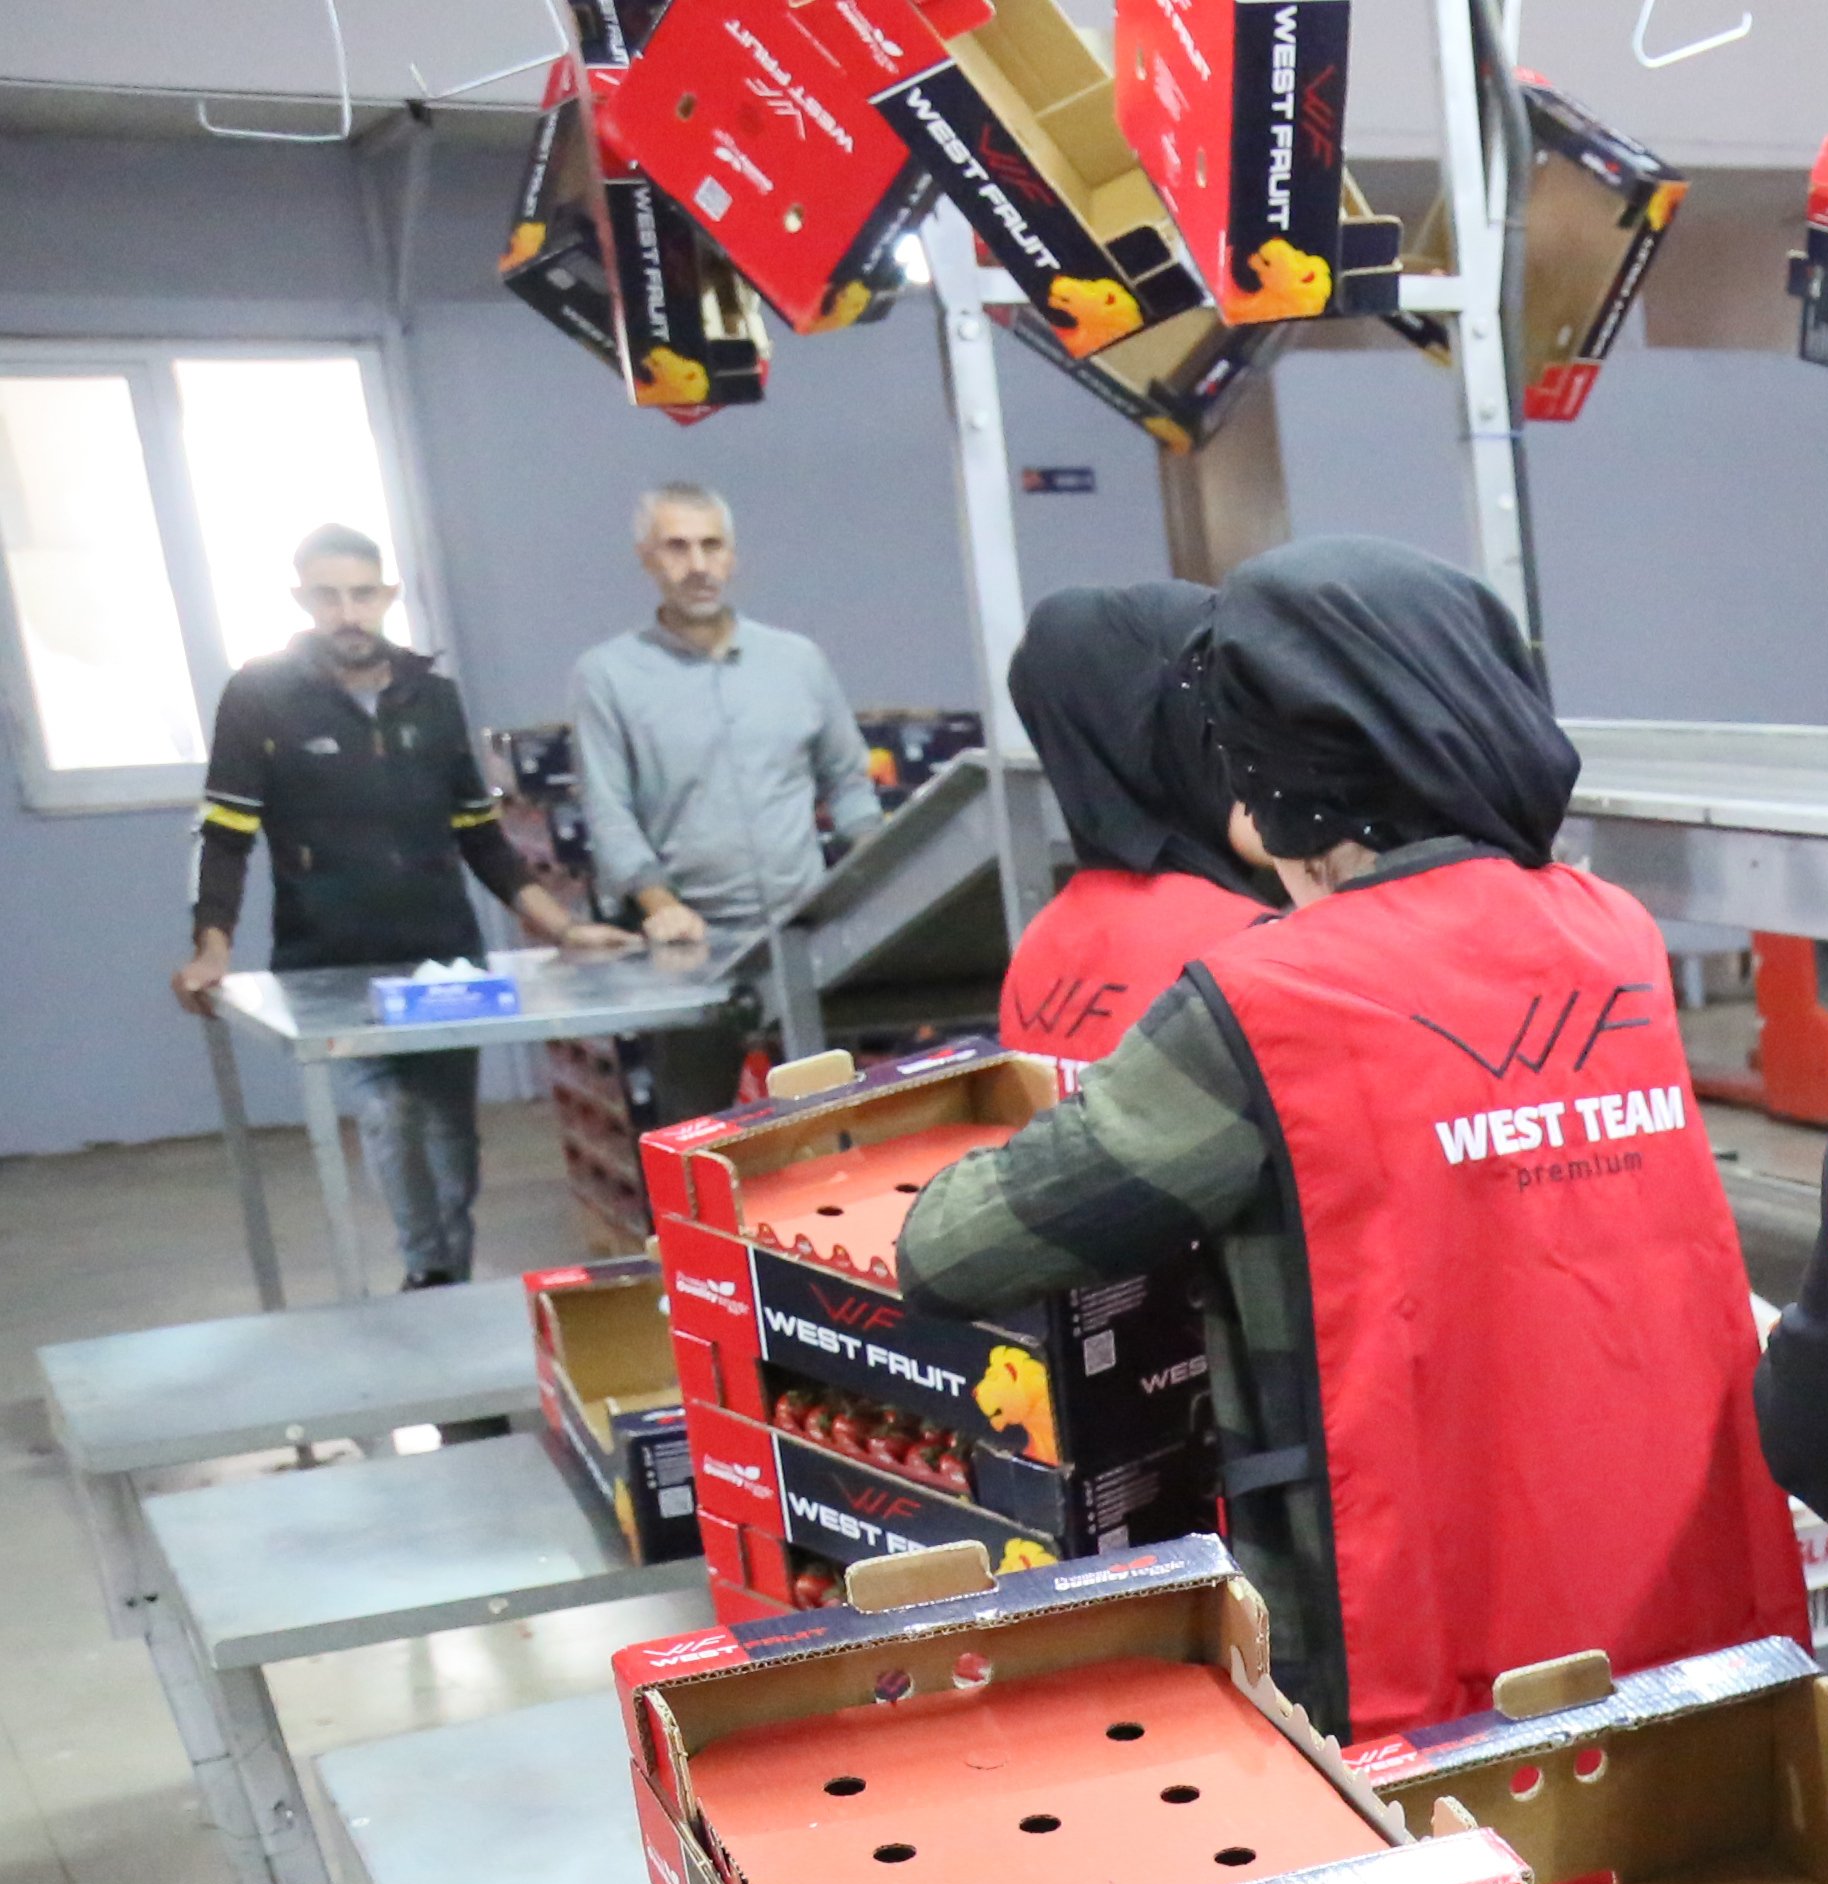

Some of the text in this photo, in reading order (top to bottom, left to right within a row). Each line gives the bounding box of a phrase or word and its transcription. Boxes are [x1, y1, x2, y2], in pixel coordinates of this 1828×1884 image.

[1266, 4, 1298, 231] WEST FRUIT
[906, 87, 1061, 270] WEST FRUIT
[1435, 1085, 1688, 1167] WEST TEAM
[1516, 1148, 1643, 1191] premium
[764, 1307, 966, 1397] WEST FRUIT
[1140, 1354, 1208, 1394] WES
[788, 1492, 882, 1546] WEST
